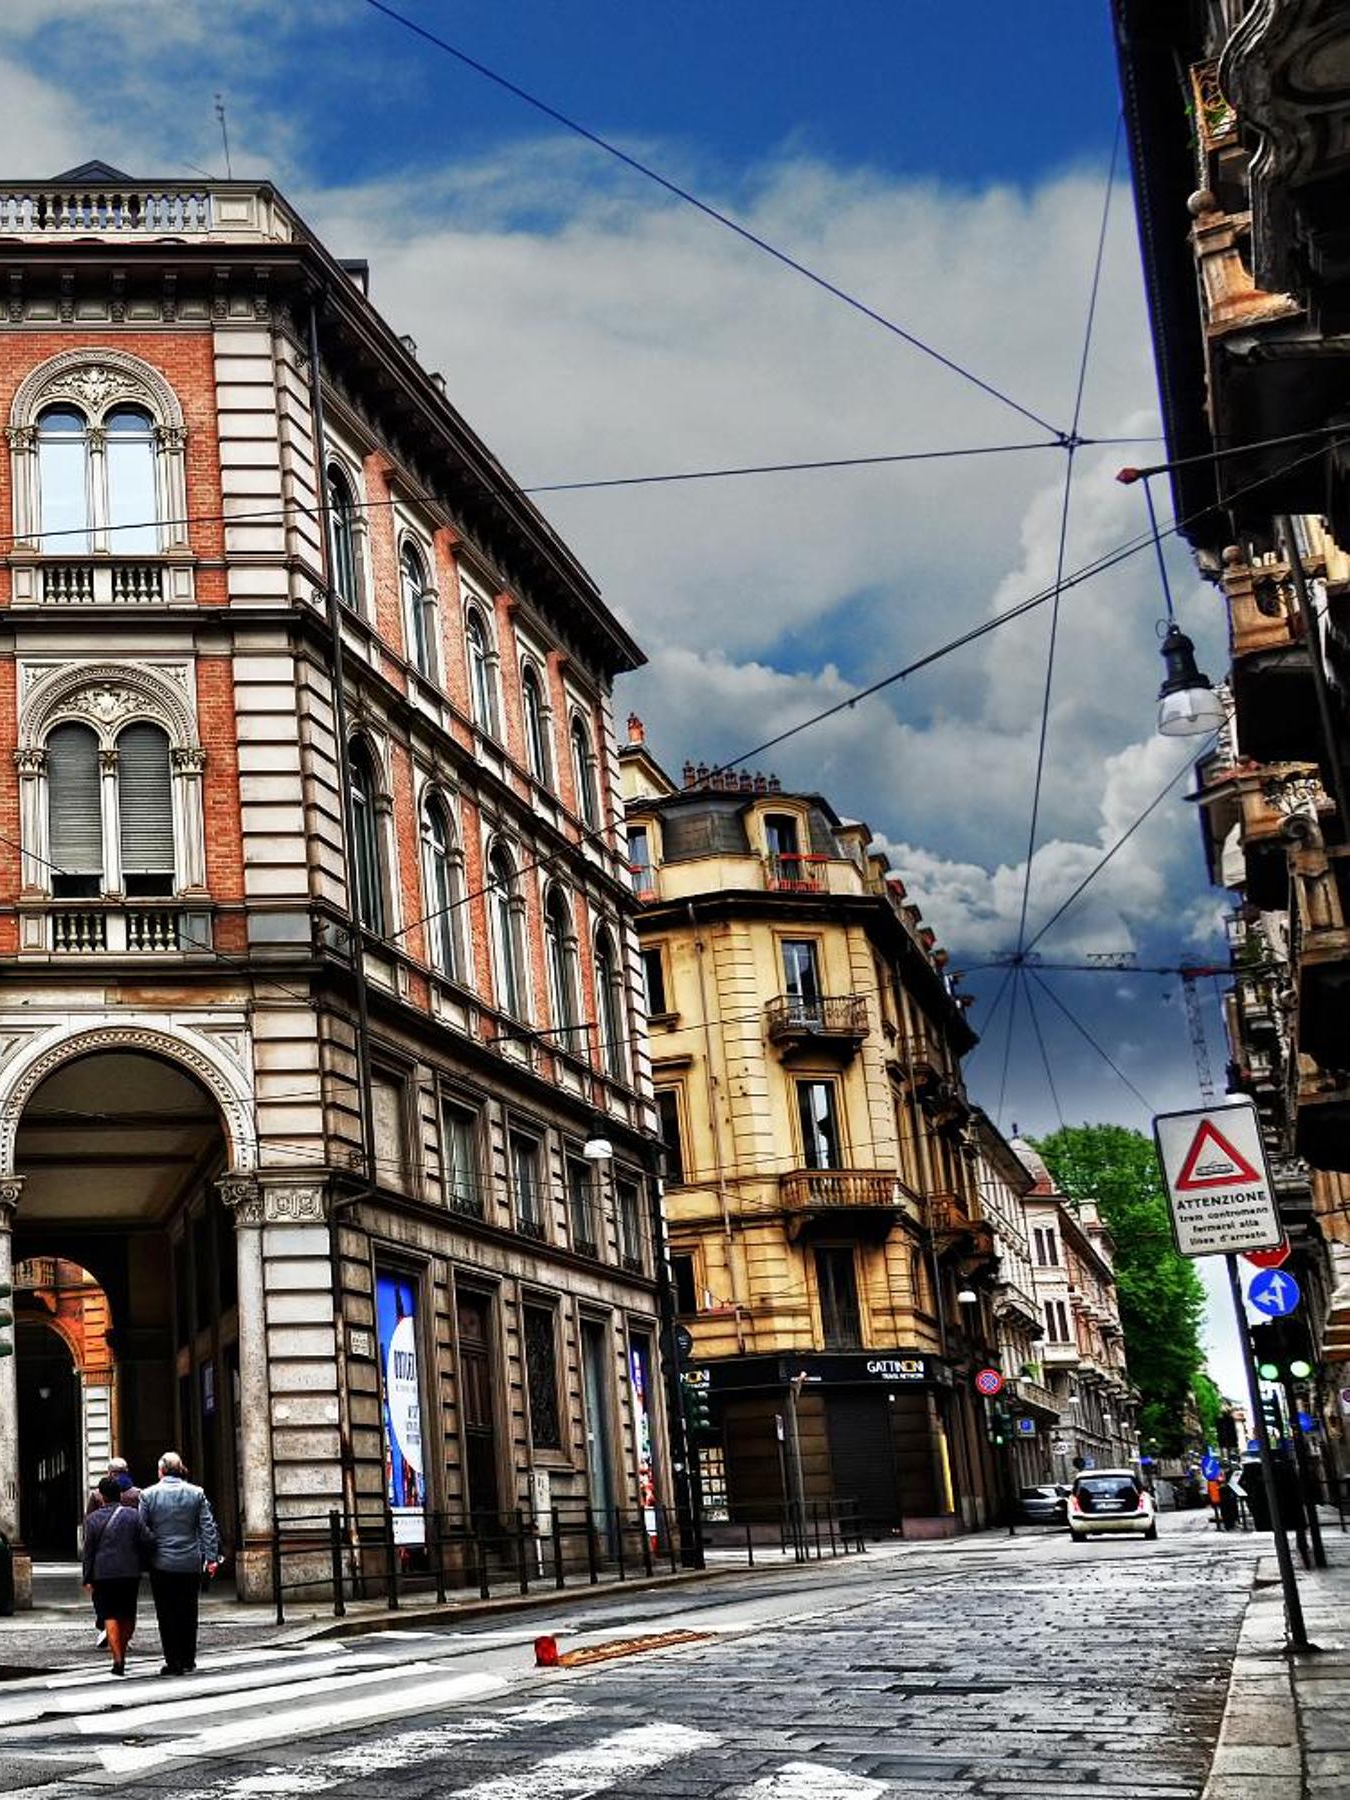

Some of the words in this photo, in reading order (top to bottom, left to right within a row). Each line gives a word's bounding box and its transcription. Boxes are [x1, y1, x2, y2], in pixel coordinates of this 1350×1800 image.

[1177, 1191, 1267, 1210] ATTENZIONE
[1179, 1214, 1203, 1223] tram
[1207, 1207, 1268, 1220] contromano
[1193, 1220, 1236, 1233] fermarsi
[1239, 1219, 1259, 1229] alla
[866, 1360, 925, 1373] GATTINONI
